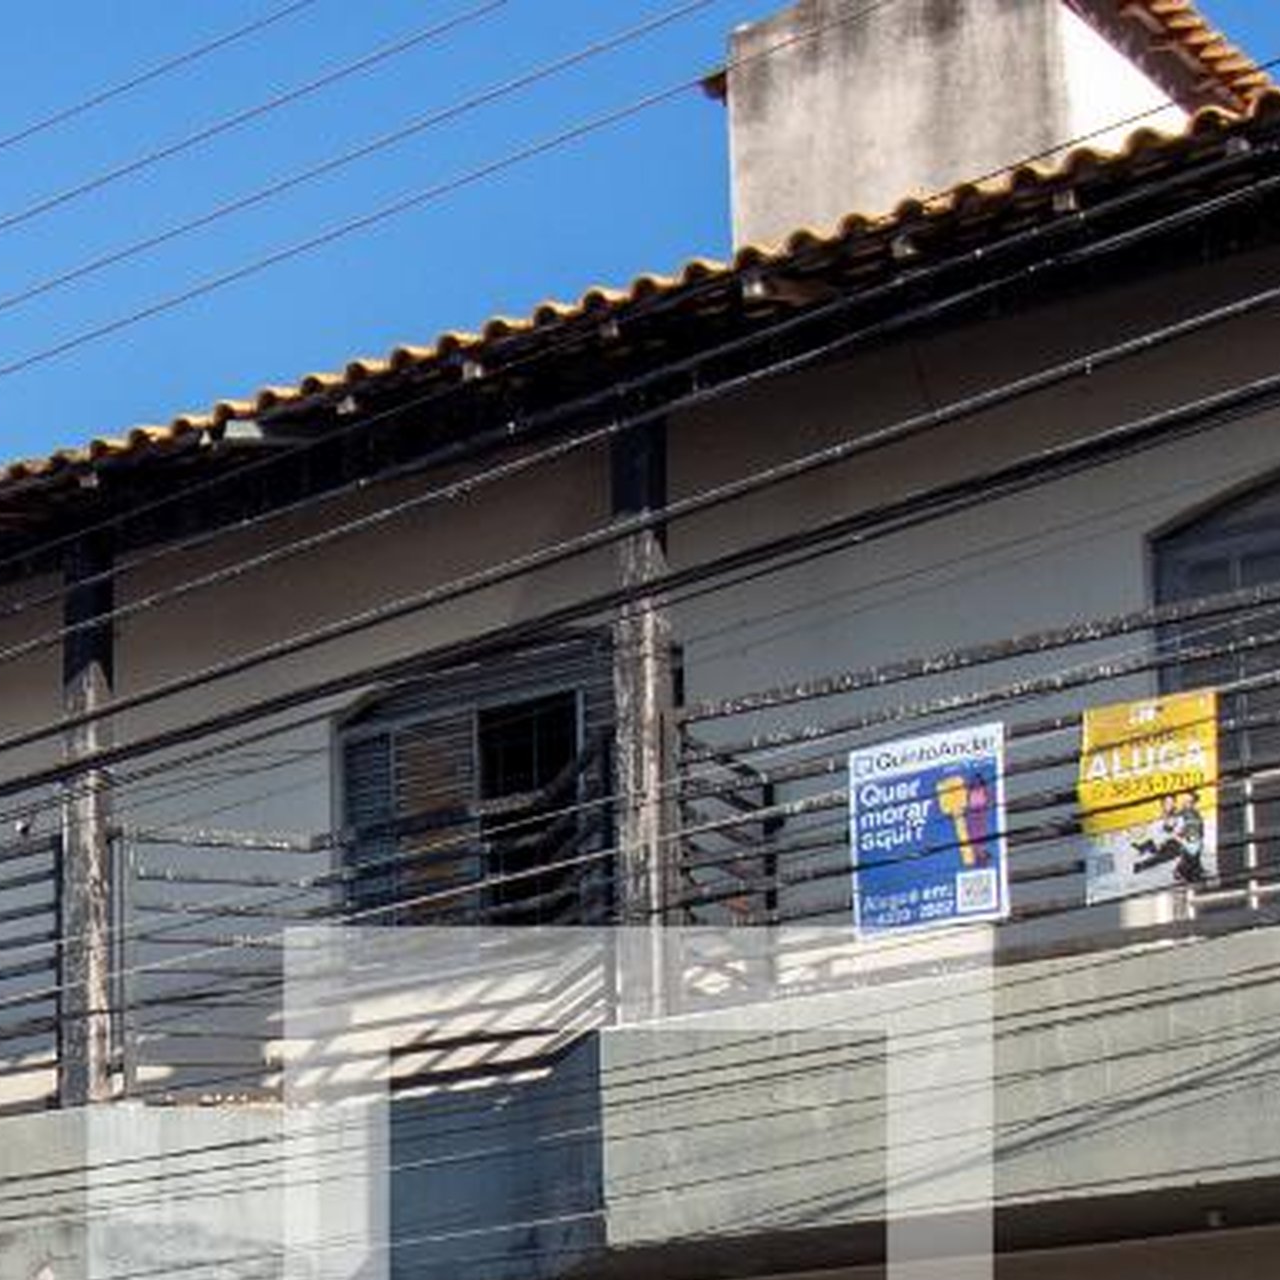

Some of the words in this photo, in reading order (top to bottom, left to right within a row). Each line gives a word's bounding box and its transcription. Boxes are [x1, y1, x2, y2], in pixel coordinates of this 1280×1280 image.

[860, 777, 921, 807] Quer
[860, 799, 933, 829] morar
[860, 817, 926, 851] aqui?
